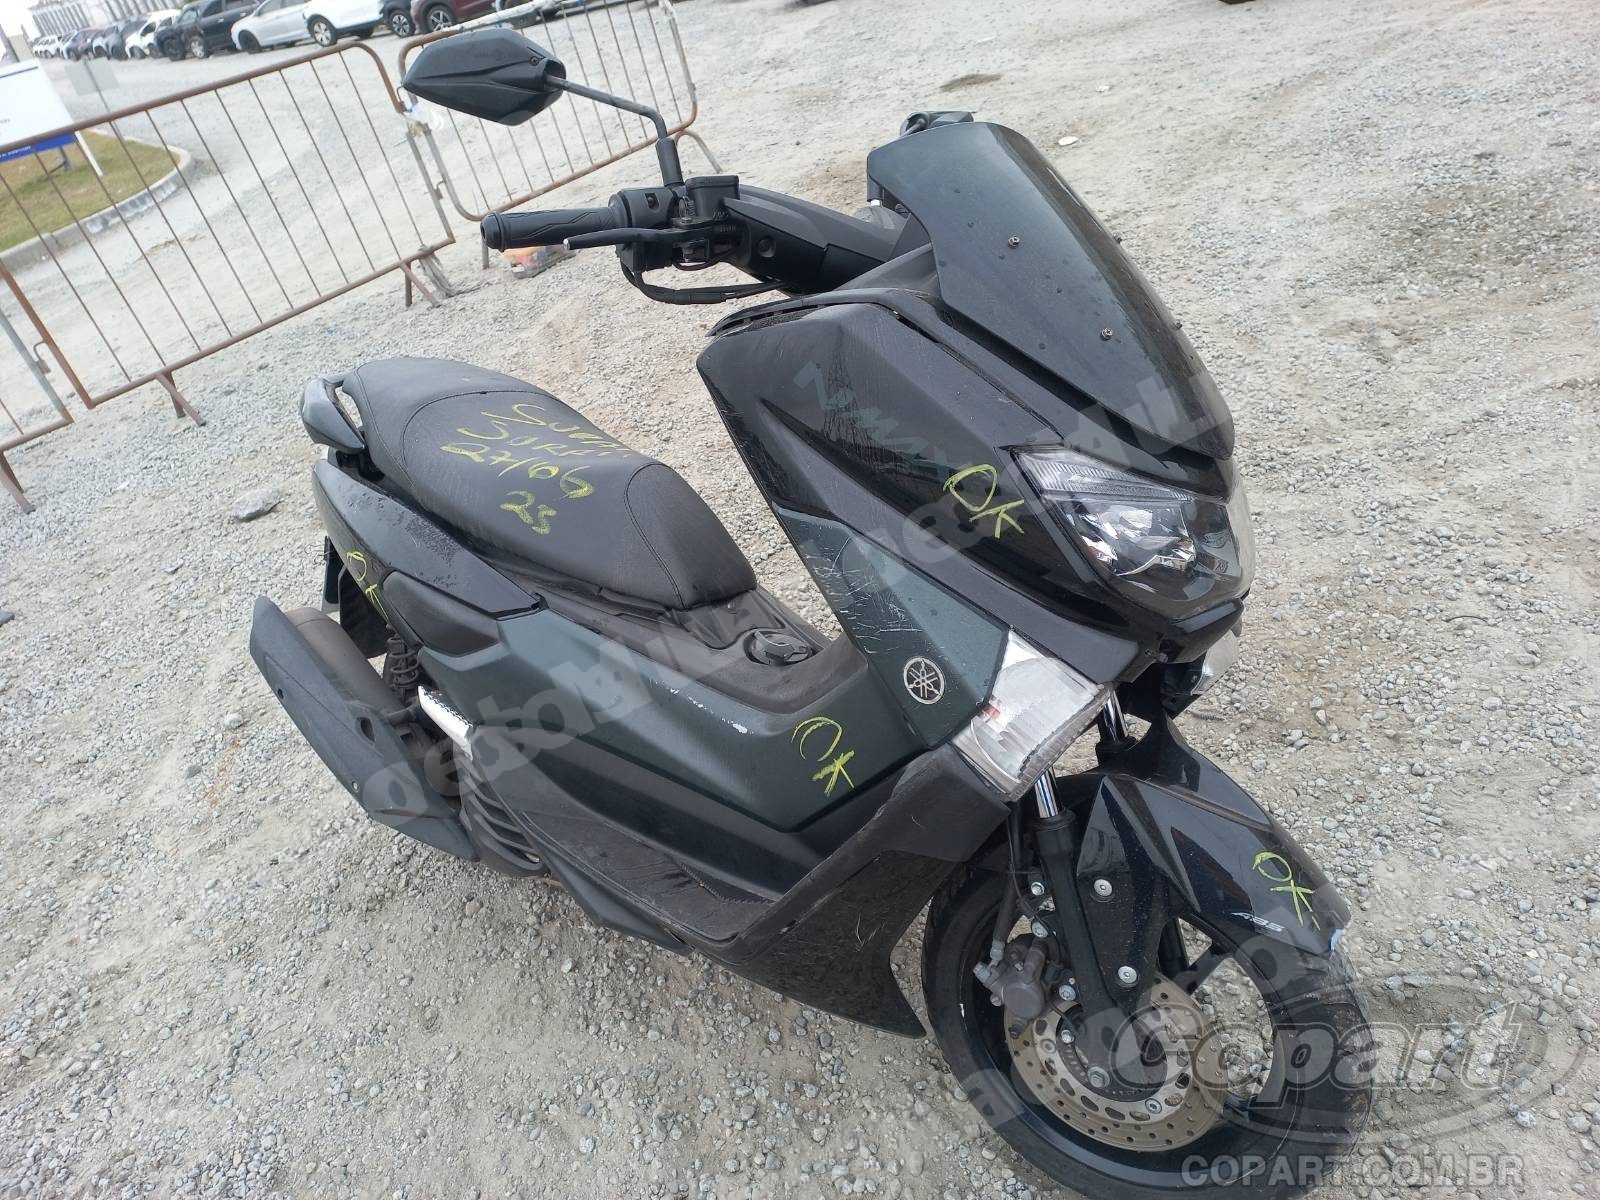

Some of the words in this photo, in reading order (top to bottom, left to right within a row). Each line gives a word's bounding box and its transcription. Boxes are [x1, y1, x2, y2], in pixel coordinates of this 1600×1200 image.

[943, 464, 1025, 539] OK
[791, 716, 854, 797] OK
[1231, 912, 1284, 932] ABS
[1252, 852, 1320, 930] OK
